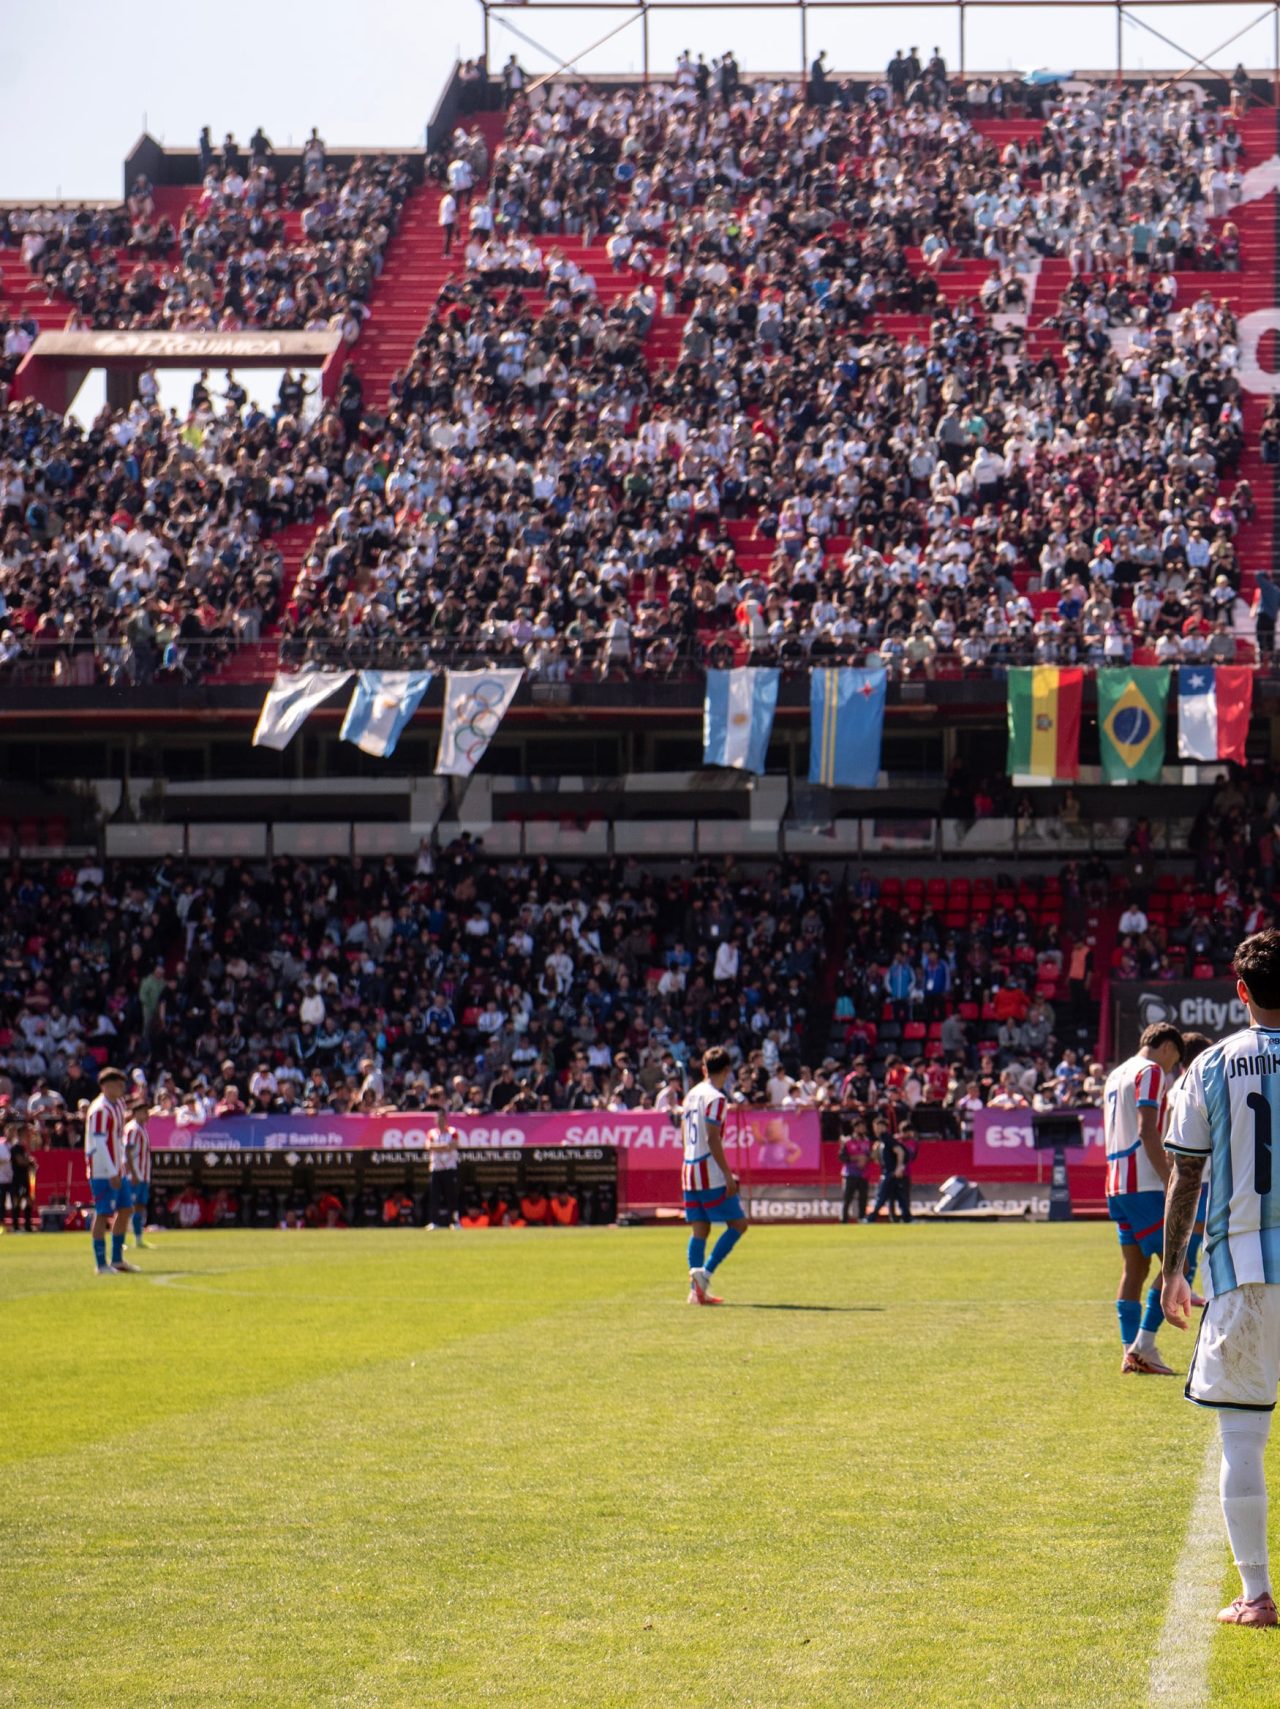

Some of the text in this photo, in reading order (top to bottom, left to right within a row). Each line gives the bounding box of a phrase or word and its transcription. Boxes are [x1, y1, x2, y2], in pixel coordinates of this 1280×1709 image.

[685, 1110, 698, 1145] 15
[1108, 1089, 1118, 1131] 7
[565, 1125, 655, 1148] SANTA
